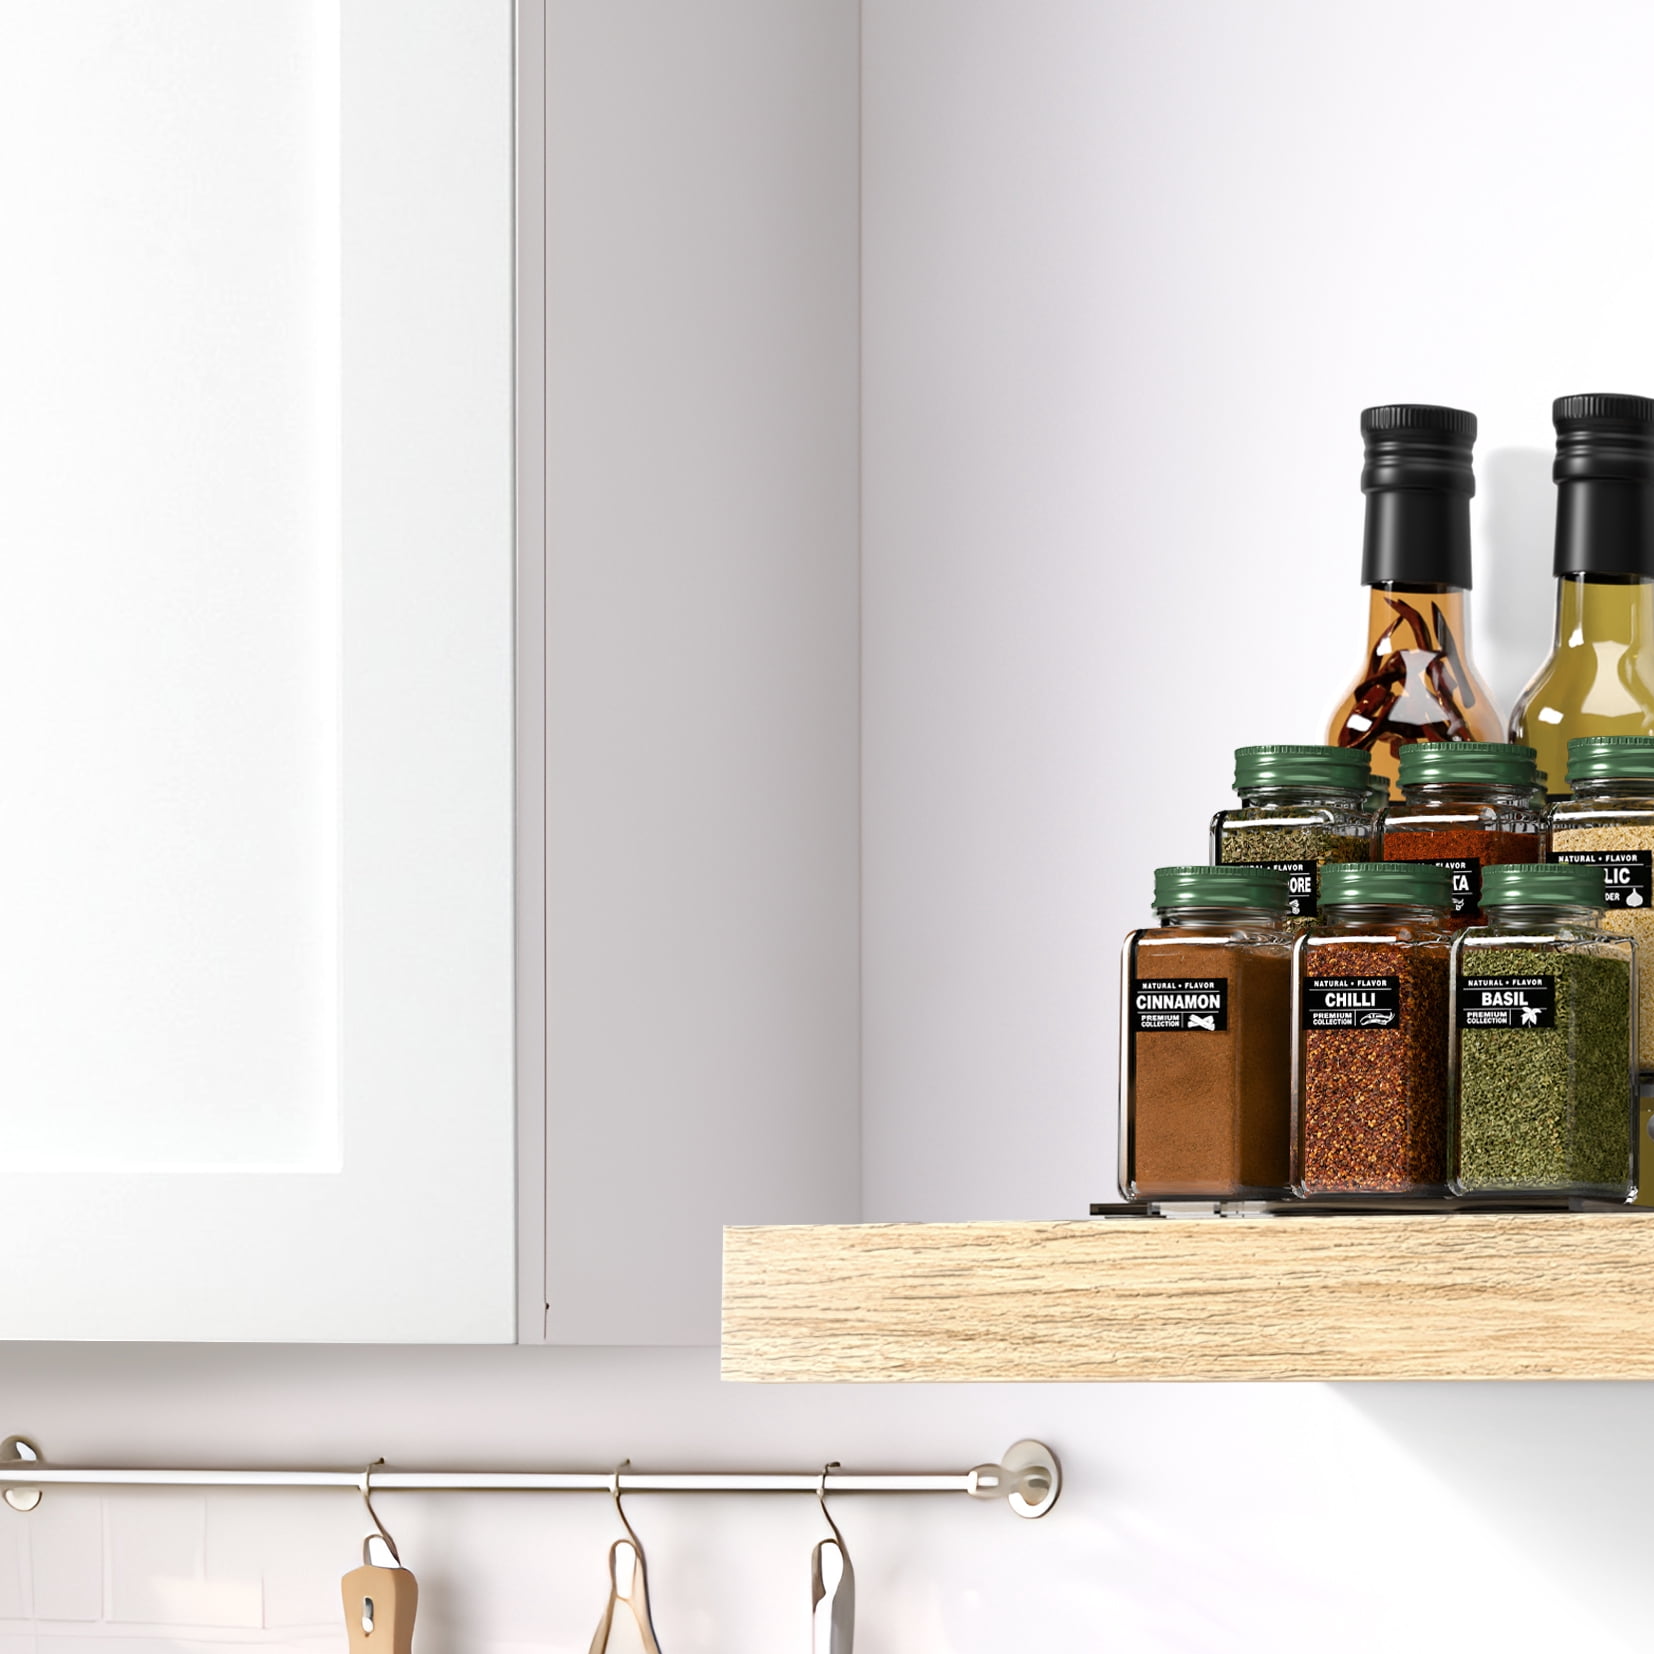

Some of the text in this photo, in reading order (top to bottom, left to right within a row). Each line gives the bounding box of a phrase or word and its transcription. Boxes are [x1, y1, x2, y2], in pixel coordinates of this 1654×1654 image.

[1558, 854, 1638, 863] NATURAL FLAVOR
[1273, 863, 1304, 871] FLAVOR
[1603, 867, 1631, 884] LIC
[1288, 876, 1312, 893] ORE
[1142, 981, 1215, 990] NATURAL FLAVOR
[1357, 979, 1387, 987] FLAVOR
[1512, 978, 1543, 986] FLAVOR
[1136, 994, 1221, 1010] CINNAMON
[1325, 992, 1376, 1007] CHILLI
[1481, 991, 1529, 1006] BASIL
[1141, 1020, 1180, 1028] COLLECTION
[1312, 1018, 1352, 1026] COLLECTION
[1466, 1017, 1507, 1025] COLLECTION
